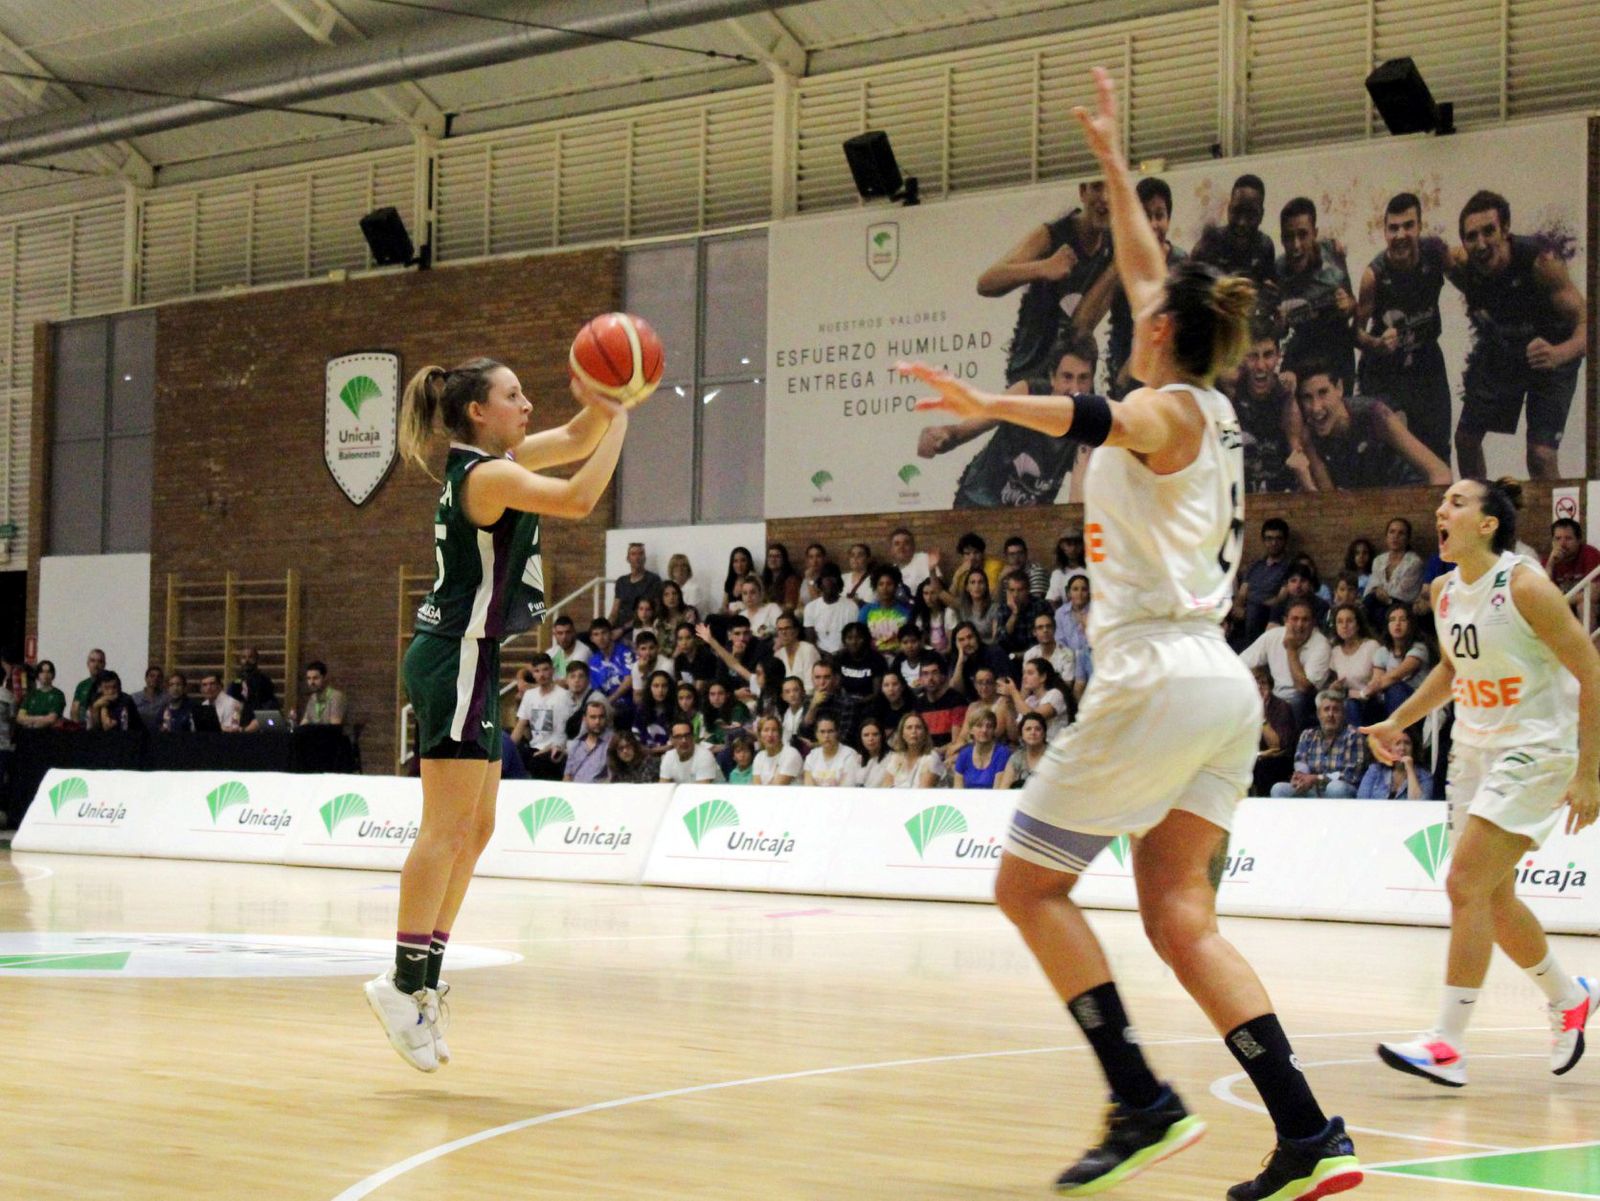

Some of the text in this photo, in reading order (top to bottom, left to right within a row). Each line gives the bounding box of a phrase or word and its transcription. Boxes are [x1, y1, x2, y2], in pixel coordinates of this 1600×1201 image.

[818, 311, 947, 333] NUESTROS VALORES
[776, 331, 992, 367] ESFUERZO HUMILDAD
[788, 361, 978, 393] ENTREGA TRJO
[843, 395, 917, 417] EQUIPO
[339, 426, 380, 445] Unicaja
[338, 450, 381, 460] Baloncesto
[1451, 624, 1479, 659] 20
[78, 801, 127, 823] Unicaja
[238, 807, 292, 829] Unicaja
[358, 820, 418, 842] Unicaja
[564, 825, 632, 850] Unicaja
[727, 831, 796, 856] Unicaja
[955, 836, 1002, 859] Unic
[1514, 859, 1587, 892] icaja
